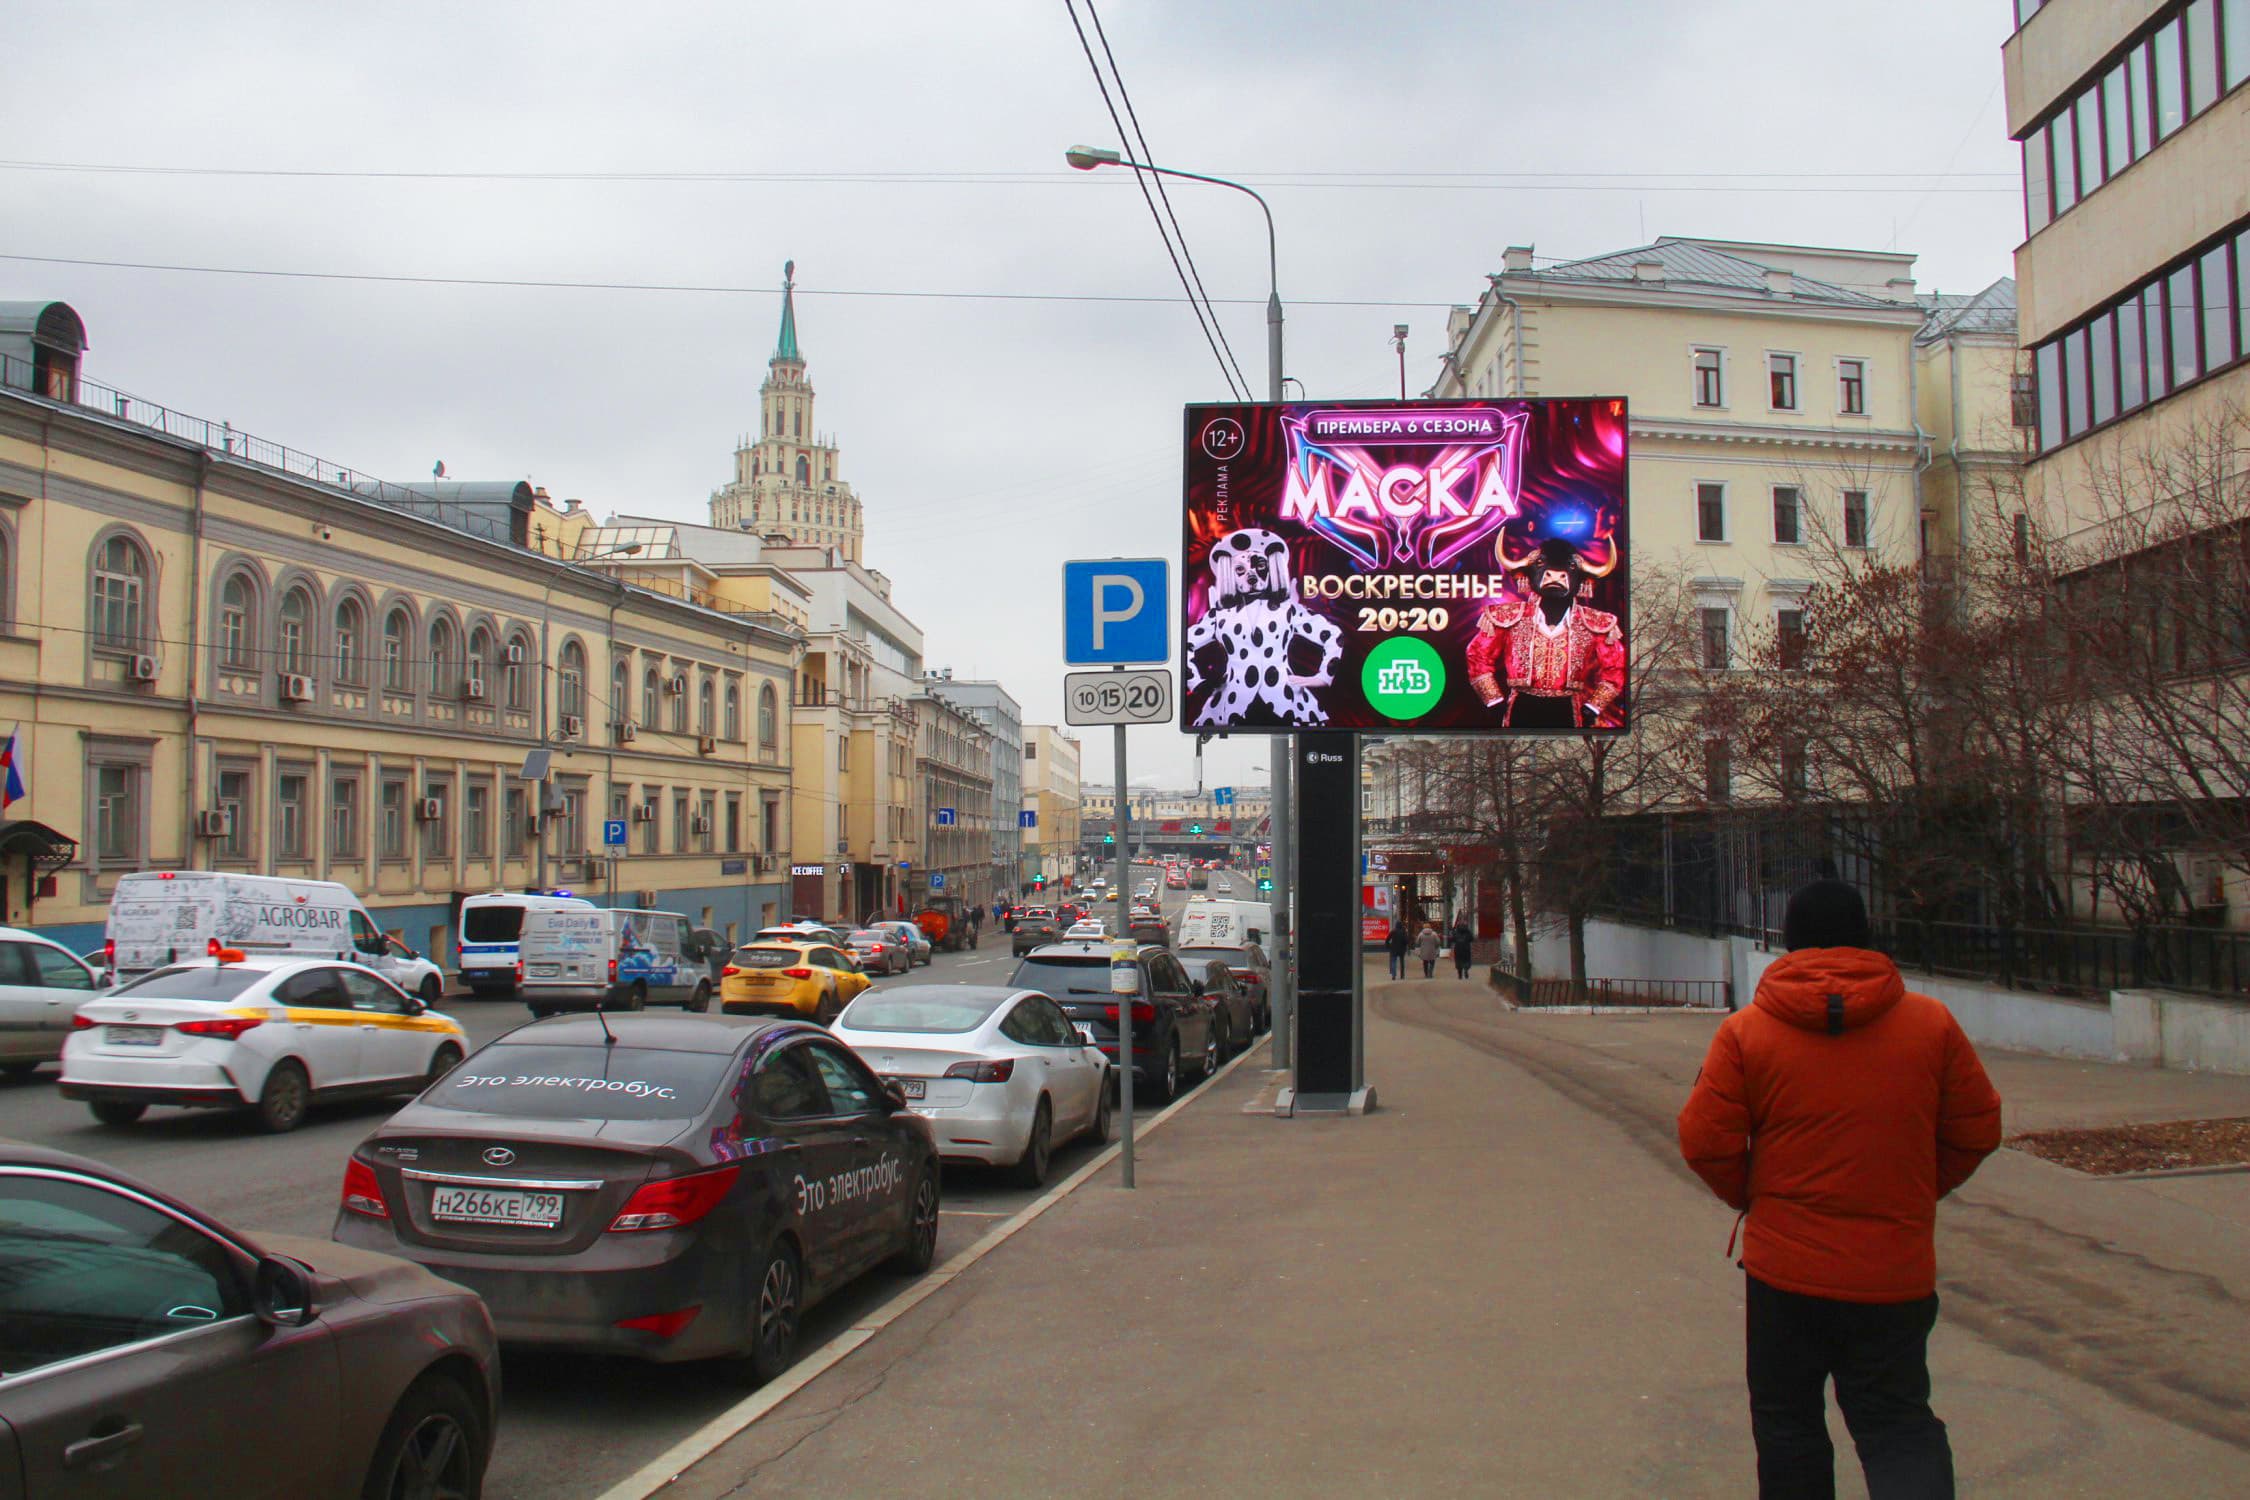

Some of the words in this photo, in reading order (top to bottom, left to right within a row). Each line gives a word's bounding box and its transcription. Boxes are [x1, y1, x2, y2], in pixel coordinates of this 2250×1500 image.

[1316, 418, 1404, 434] ПРЕМЬЕРА
[1407, 419, 1418, 433] 6
[1423, 419, 1493, 433] СЕЗОНА
[1208, 429, 1239, 448] 12+
[1217, 464, 1229, 521] РЕКЛАМА
[1281, 462, 1518, 522] МАСКА
[1302, 574, 1503, 600] ВОСКРЕСЕНЬЕ
[1092, 574, 1145, 651] P
[1357, 607, 1449, 632] 20:20
[1378, 659, 1432, 695] НТВ
[1078, 691, 1095, 706] 10
[1101, 688, 1121, 707] 15
[1128, 685, 1160, 708] 20
[1320, 753, 1343, 762] Russ
[608, 823, 622, 842] P
[258, 906, 341, 929] AGROBAR
[457, 1075, 506, 1088] Это
[511, 1076, 676, 1099] электробус.
[794, 1174, 824, 1215] Это
[829, 1152, 902, 1204] электробус.
